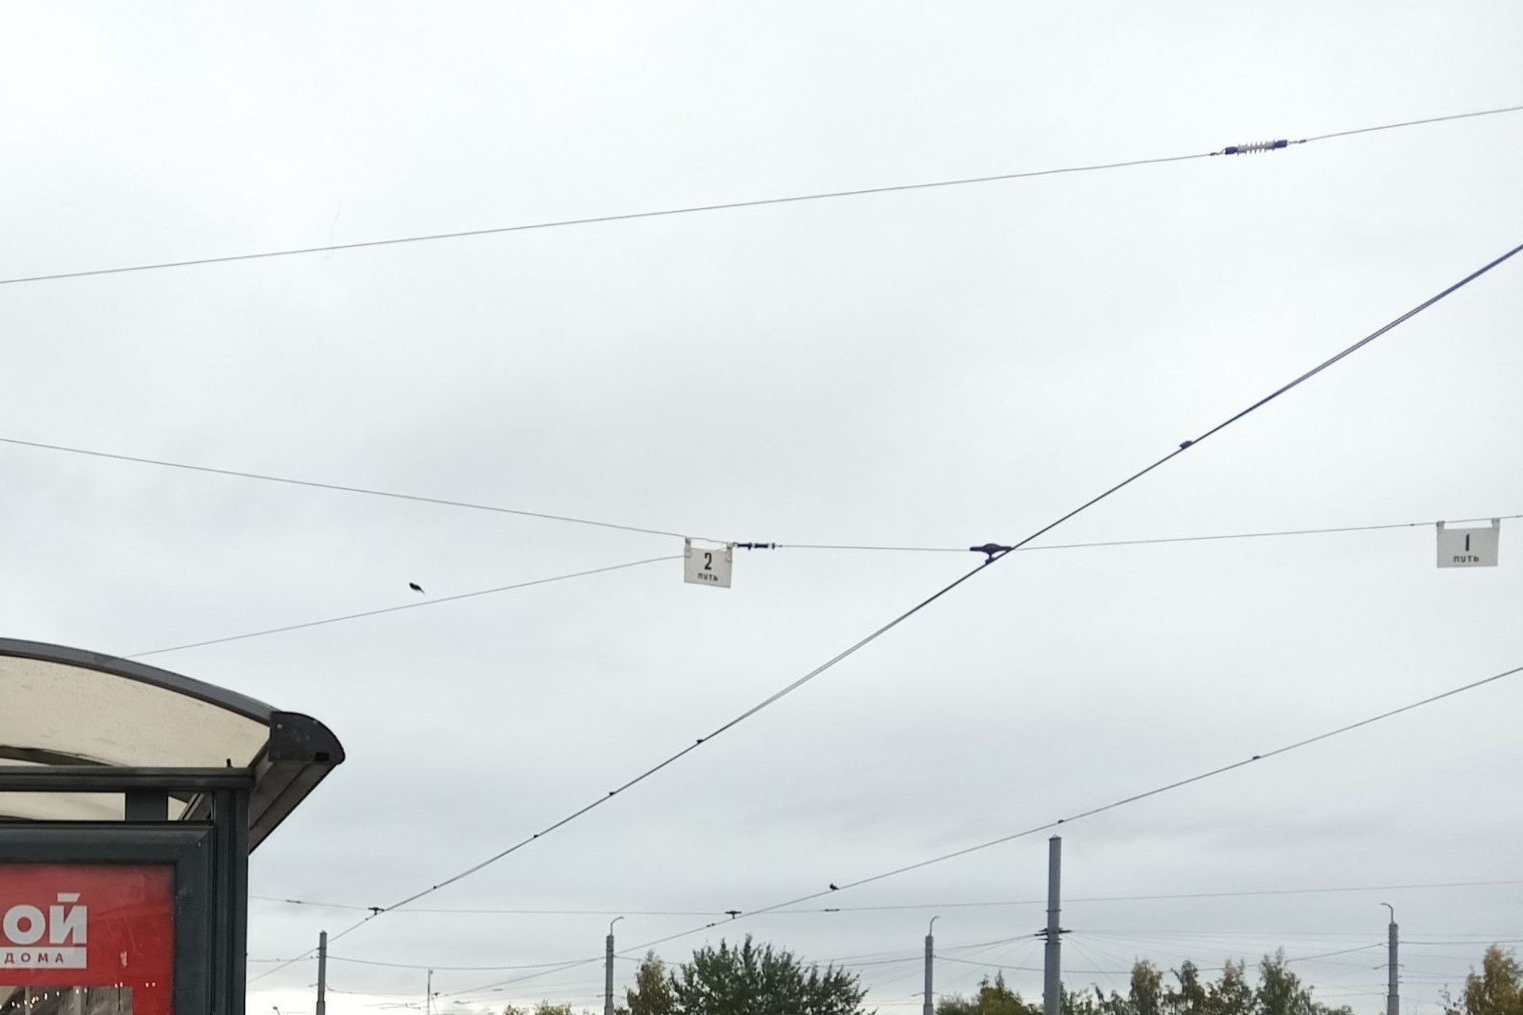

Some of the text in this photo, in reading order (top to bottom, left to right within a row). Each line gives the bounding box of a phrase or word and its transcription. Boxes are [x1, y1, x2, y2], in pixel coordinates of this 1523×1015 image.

[1465, 533, 1470, 552] 1
[704, 552, 712, 570] 2
[4, 952, 65, 965] ДОМА
